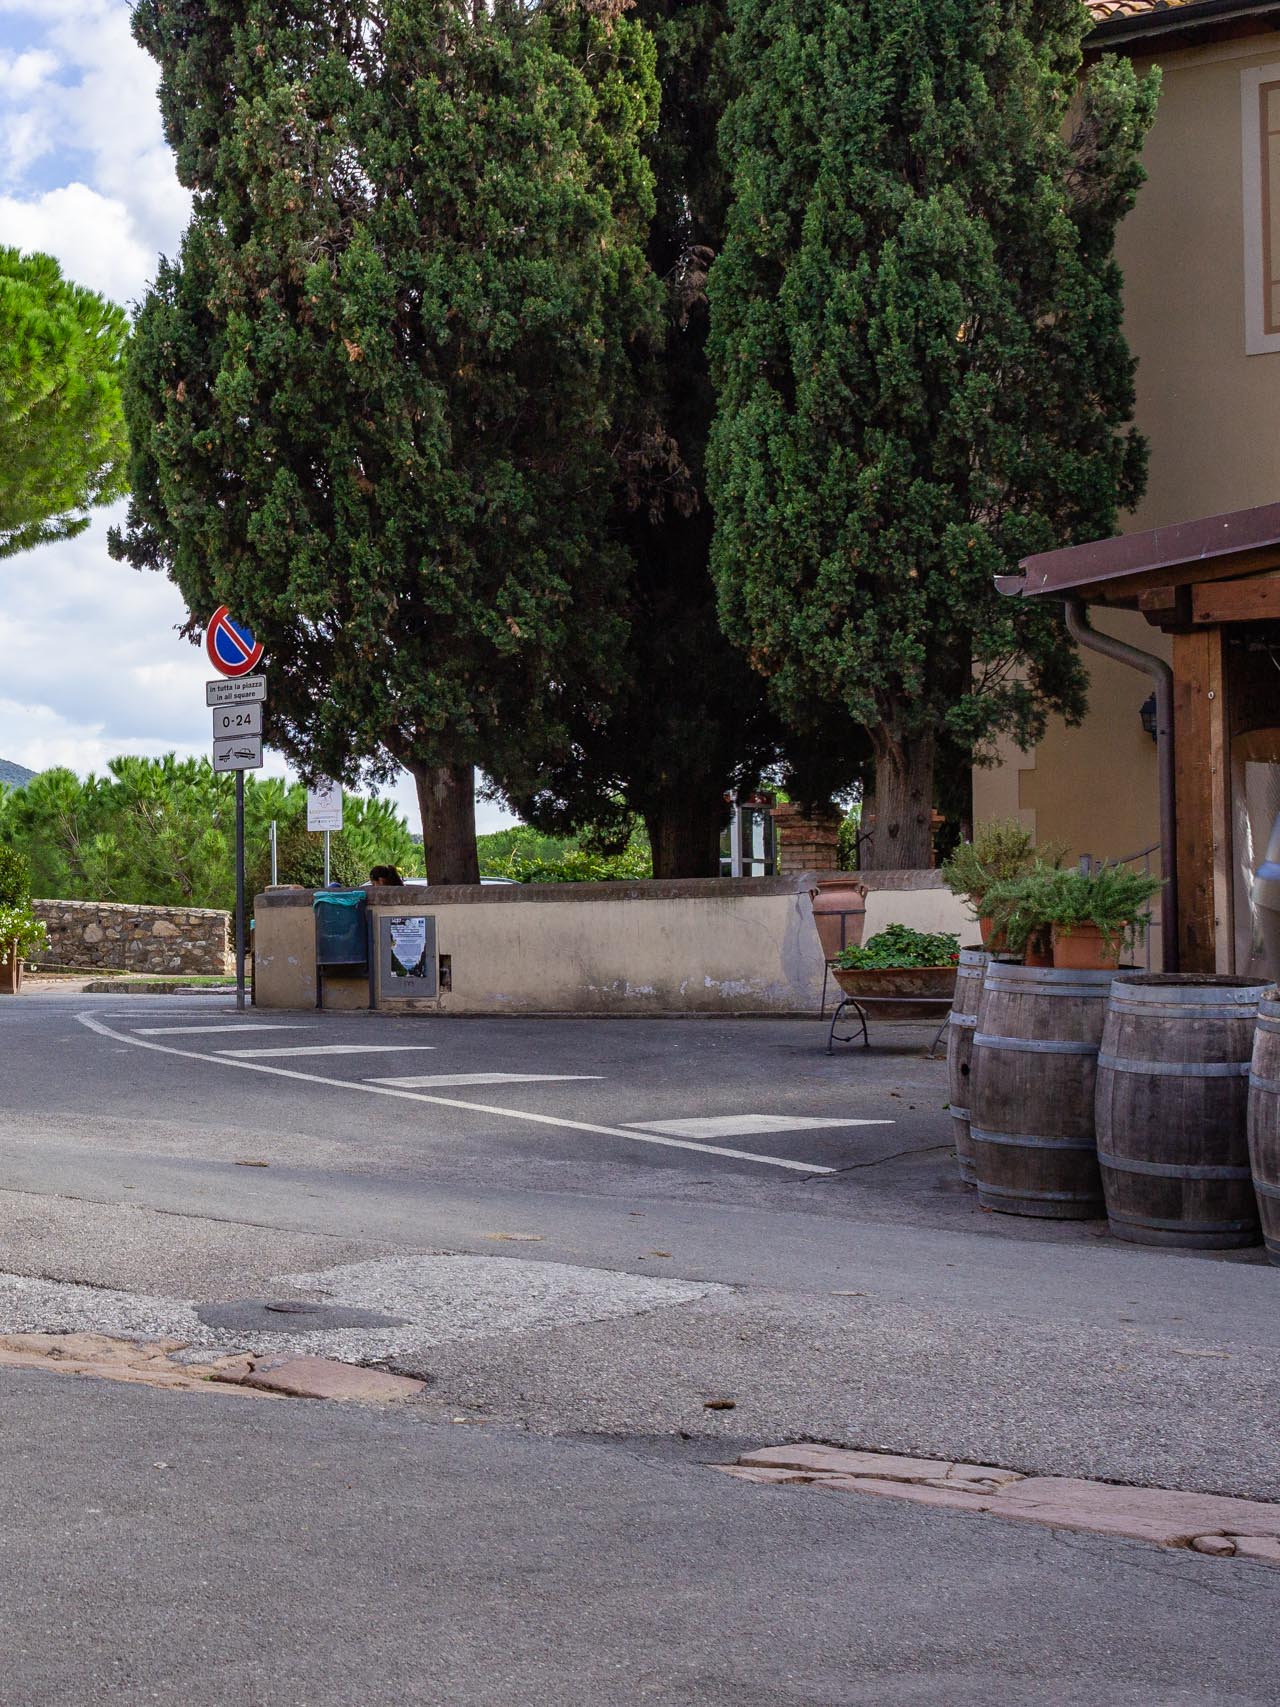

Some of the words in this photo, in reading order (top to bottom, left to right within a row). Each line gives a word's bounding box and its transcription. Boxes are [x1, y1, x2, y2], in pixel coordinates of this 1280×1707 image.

[217, 684, 233, 692] tutta
[242, 681, 263, 690] piazza
[233, 691, 256, 701] square
[222, 713, 251, 728] 0-24
